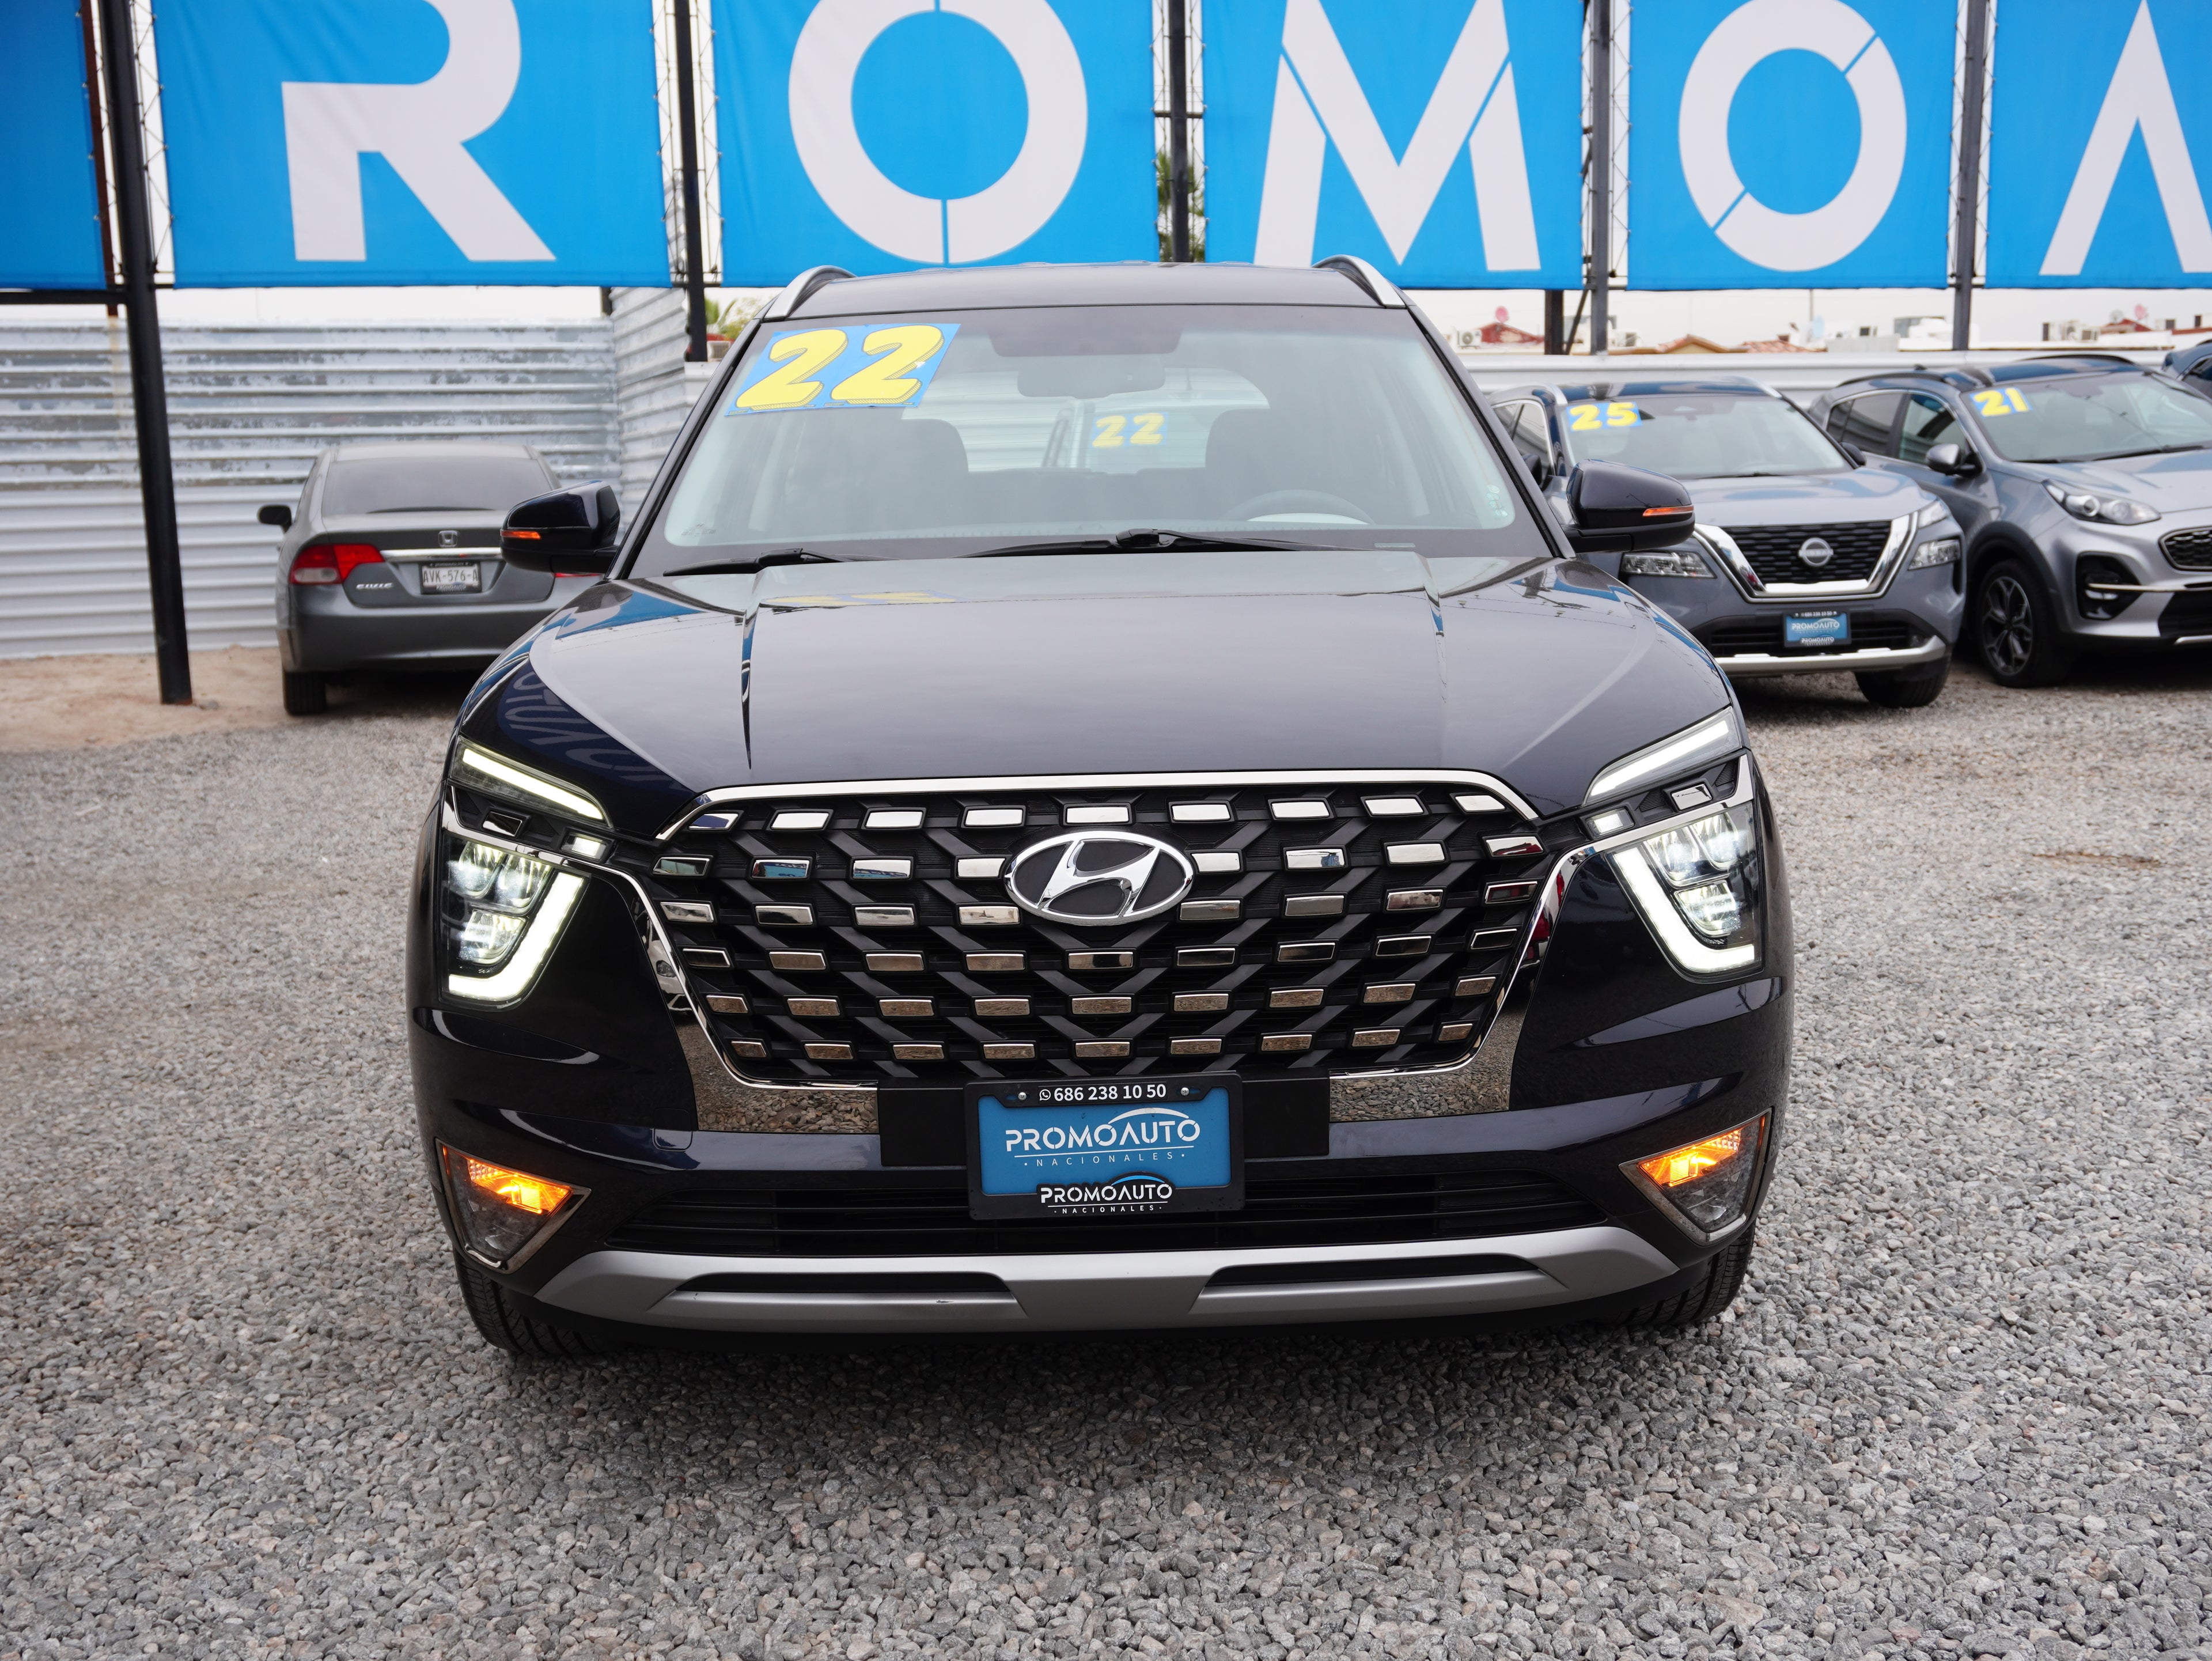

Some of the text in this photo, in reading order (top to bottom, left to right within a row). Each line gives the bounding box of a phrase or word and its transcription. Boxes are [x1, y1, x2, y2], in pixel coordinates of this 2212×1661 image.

[736, 324, 945, 411] 22
[1974, 388, 2029, 417] 21
[1569, 402, 1638, 430] 25
[1092, 413, 1164, 448] 22
[423, 569, 478, 582] AVK-576-A
[1791, 621, 1840, 630] PROMOAUTO
[1054, 1084, 1166, 1102] 686 238 10 50
[1005, 1118, 1200, 1152] PROMOAUTO
[1036, 1152, 1173, 1167] NACIONALES
[1040, 1183, 1173, 1204] PROMOAUTO
[1062, 1205, 1154, 1214] NACIONALES
